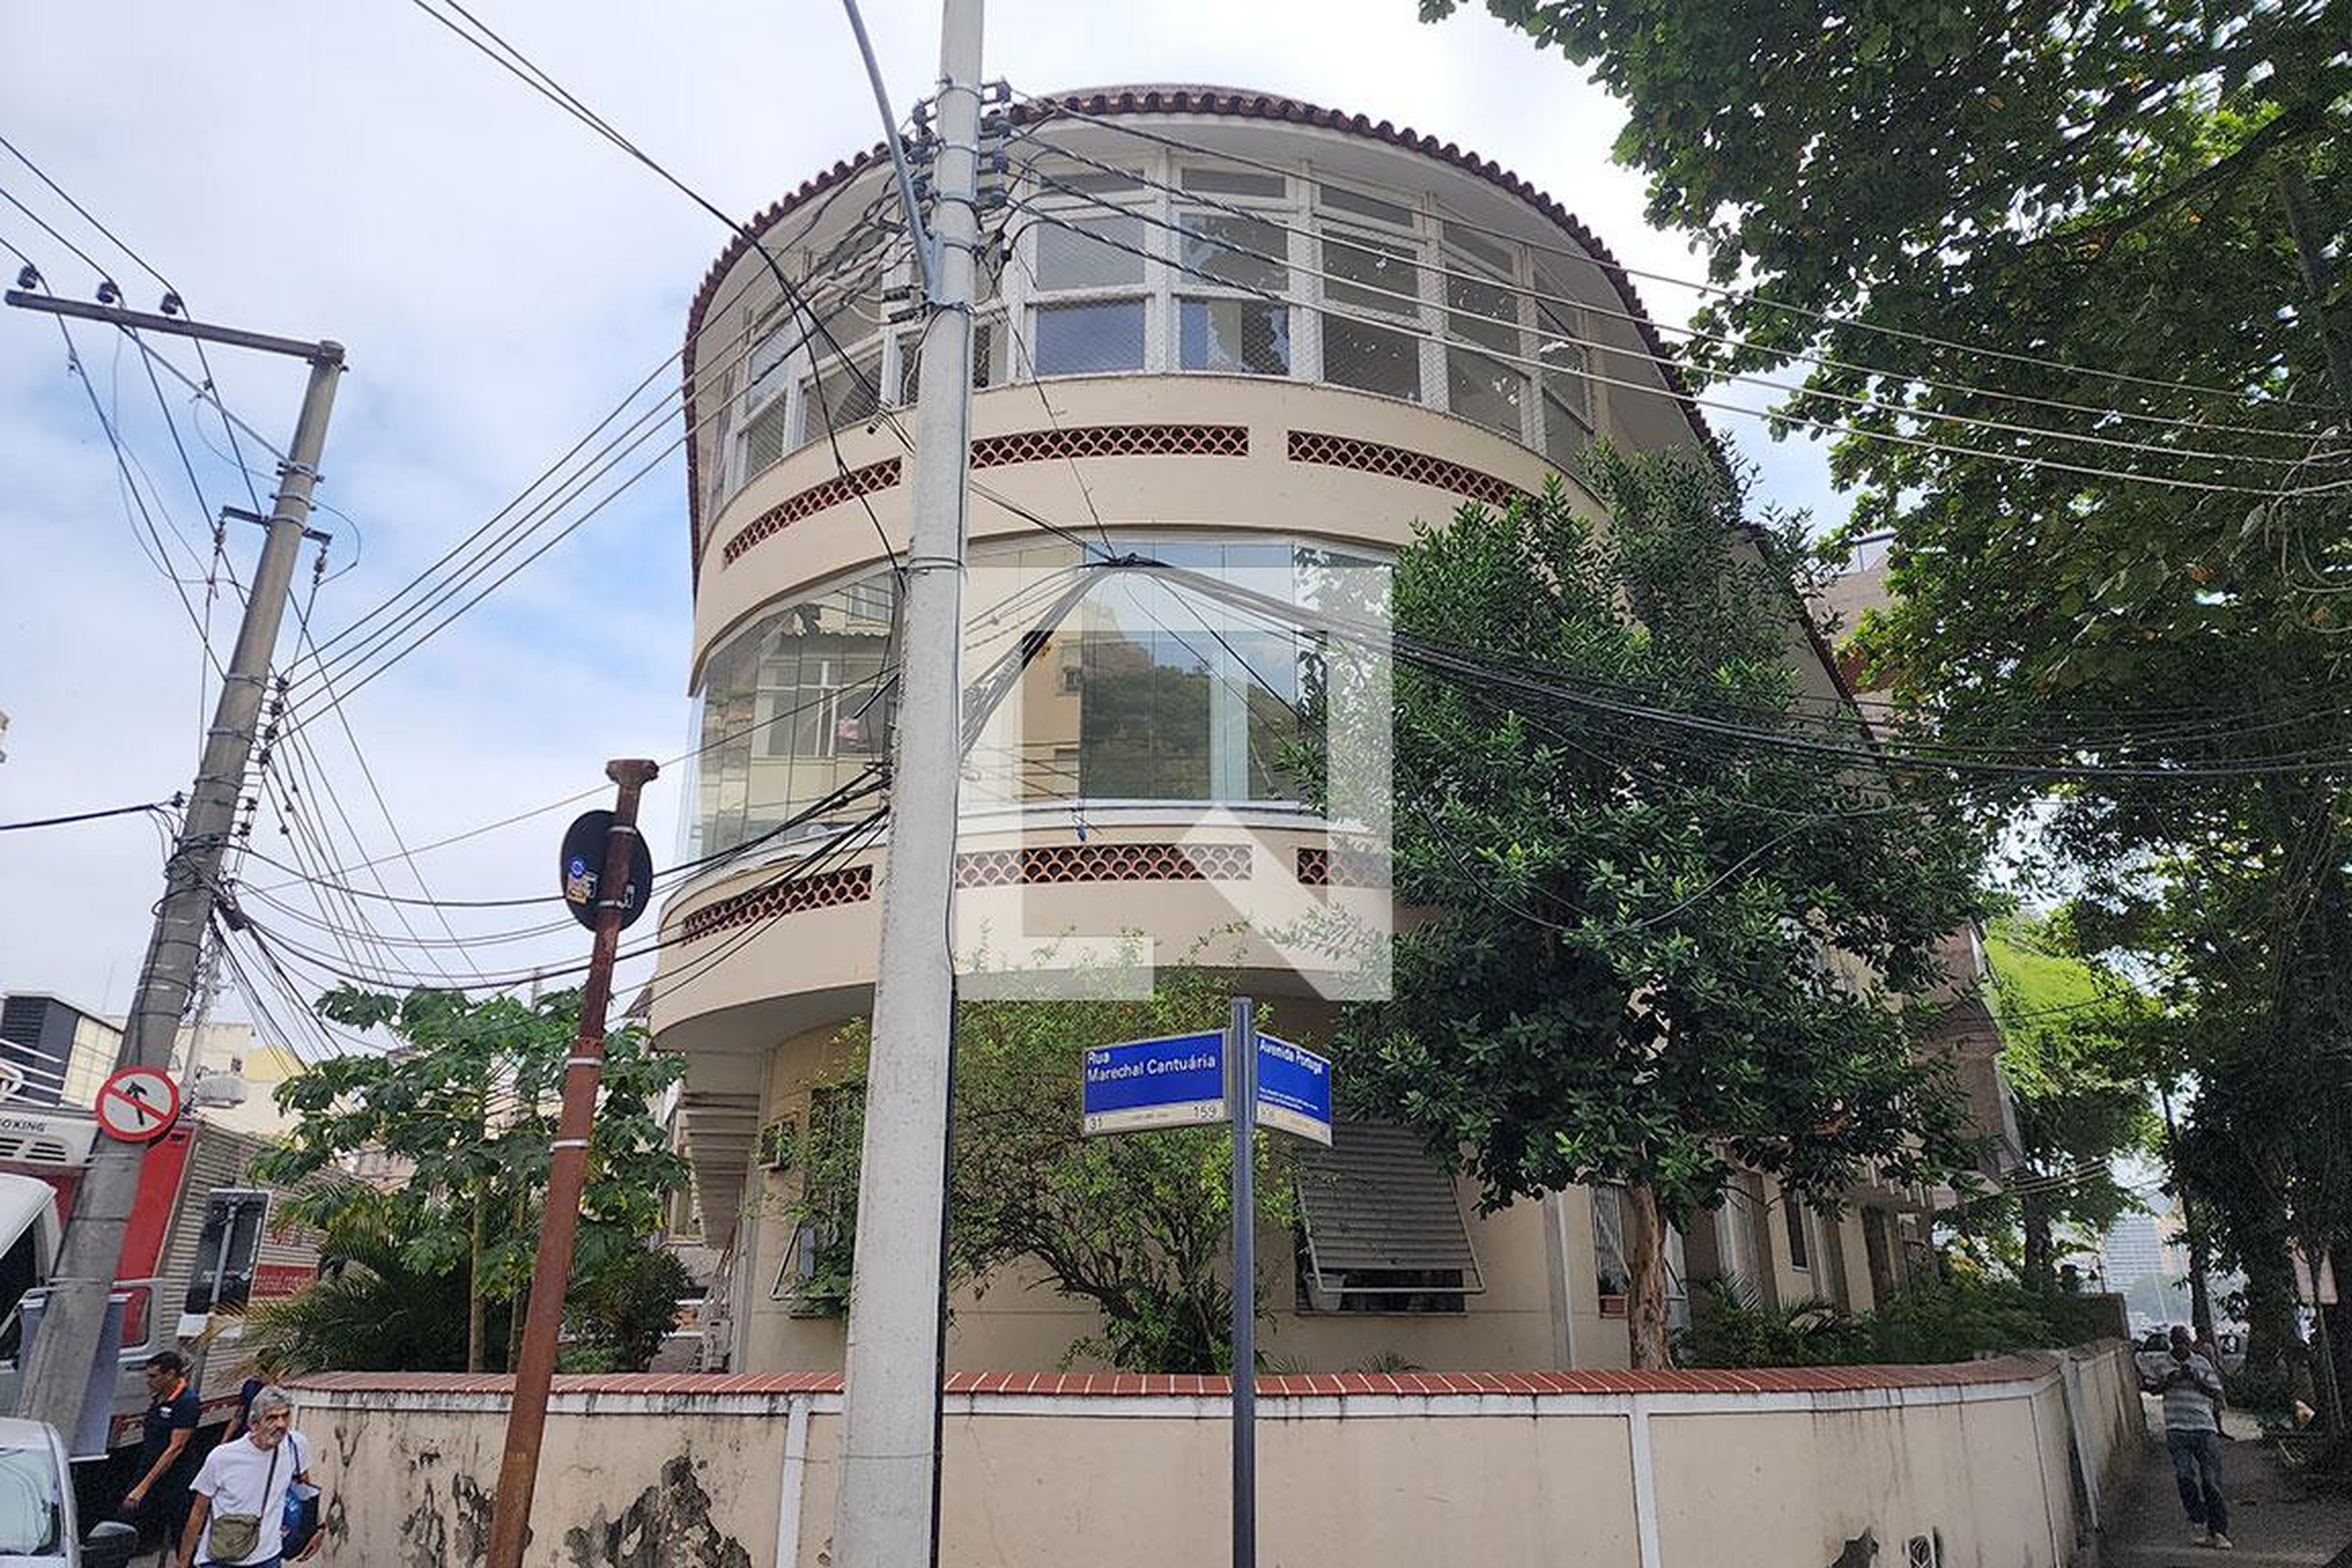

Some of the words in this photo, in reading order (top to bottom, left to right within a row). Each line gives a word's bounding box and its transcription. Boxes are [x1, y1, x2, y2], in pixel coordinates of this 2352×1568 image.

[1088, 1051, 1110, 1065] Rua
[1088, 1061, 1144, 1081] Marechal
[1147, 1054, 1216, 1074] Cantuária
[1194, 1105, 1217, 1118] 159
